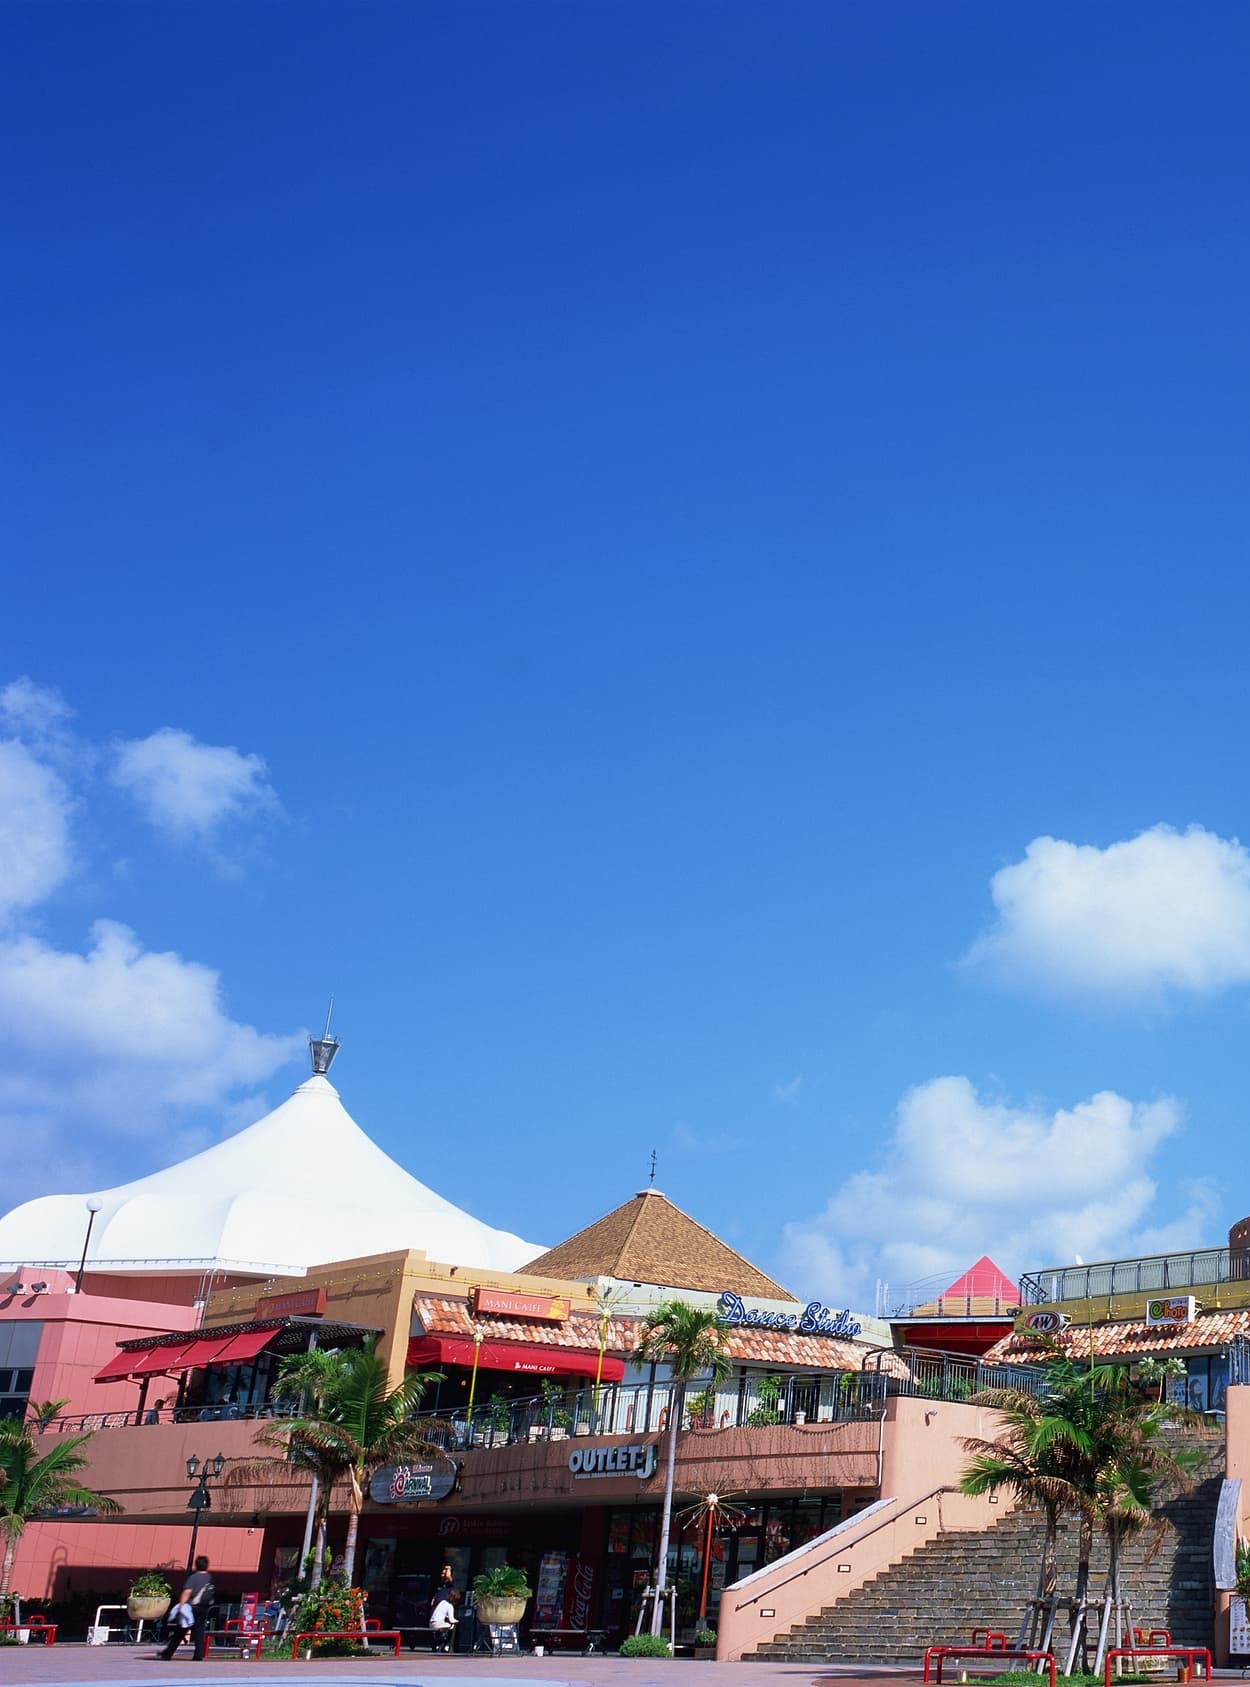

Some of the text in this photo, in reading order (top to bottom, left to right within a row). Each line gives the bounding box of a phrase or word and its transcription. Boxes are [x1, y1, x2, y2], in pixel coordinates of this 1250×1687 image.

[485, 1299, 512, 1310] MANI
[717, 1291, 862, 1337] Dance Studio
[522, 1362, 538, 1370] MANI
[568, 1445, 654, 1479] OUTLET-J
